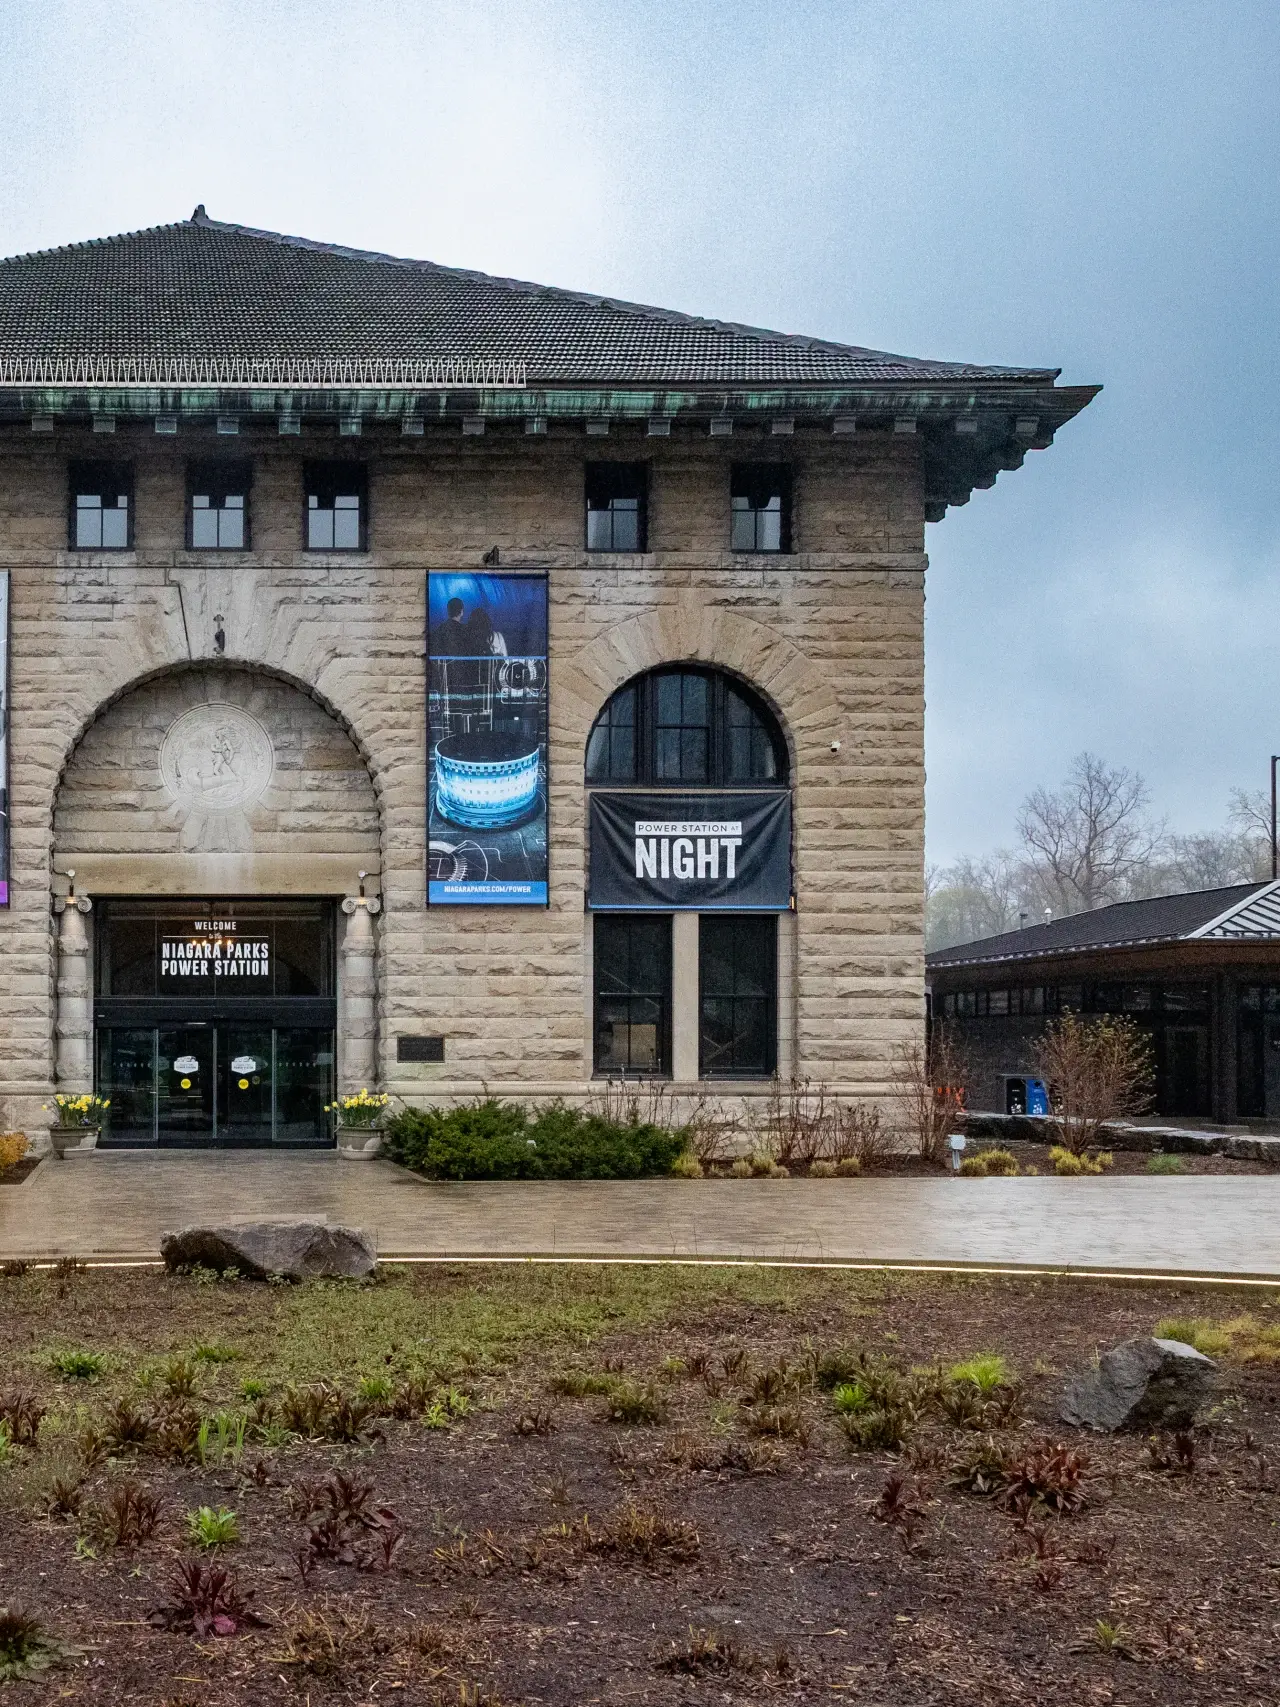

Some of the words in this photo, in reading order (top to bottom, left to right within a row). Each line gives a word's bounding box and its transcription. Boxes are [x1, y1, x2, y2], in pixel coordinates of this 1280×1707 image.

[638, 824, 677, 832] POWER
[681, 824, 727, 832] STATION
[635, 837, 742, 879] NIGHT
[444, 885, 531, 893] NIAGARAPARKS.COM/POWER
[194, 921, 237, 930] WELCOME
[162, 943, 221, 959] NIAGARA
[226, 943, 269, 959] PARKS
[161, 960, 208, 976] POWER
[214, 960, 269, 976] STATION
